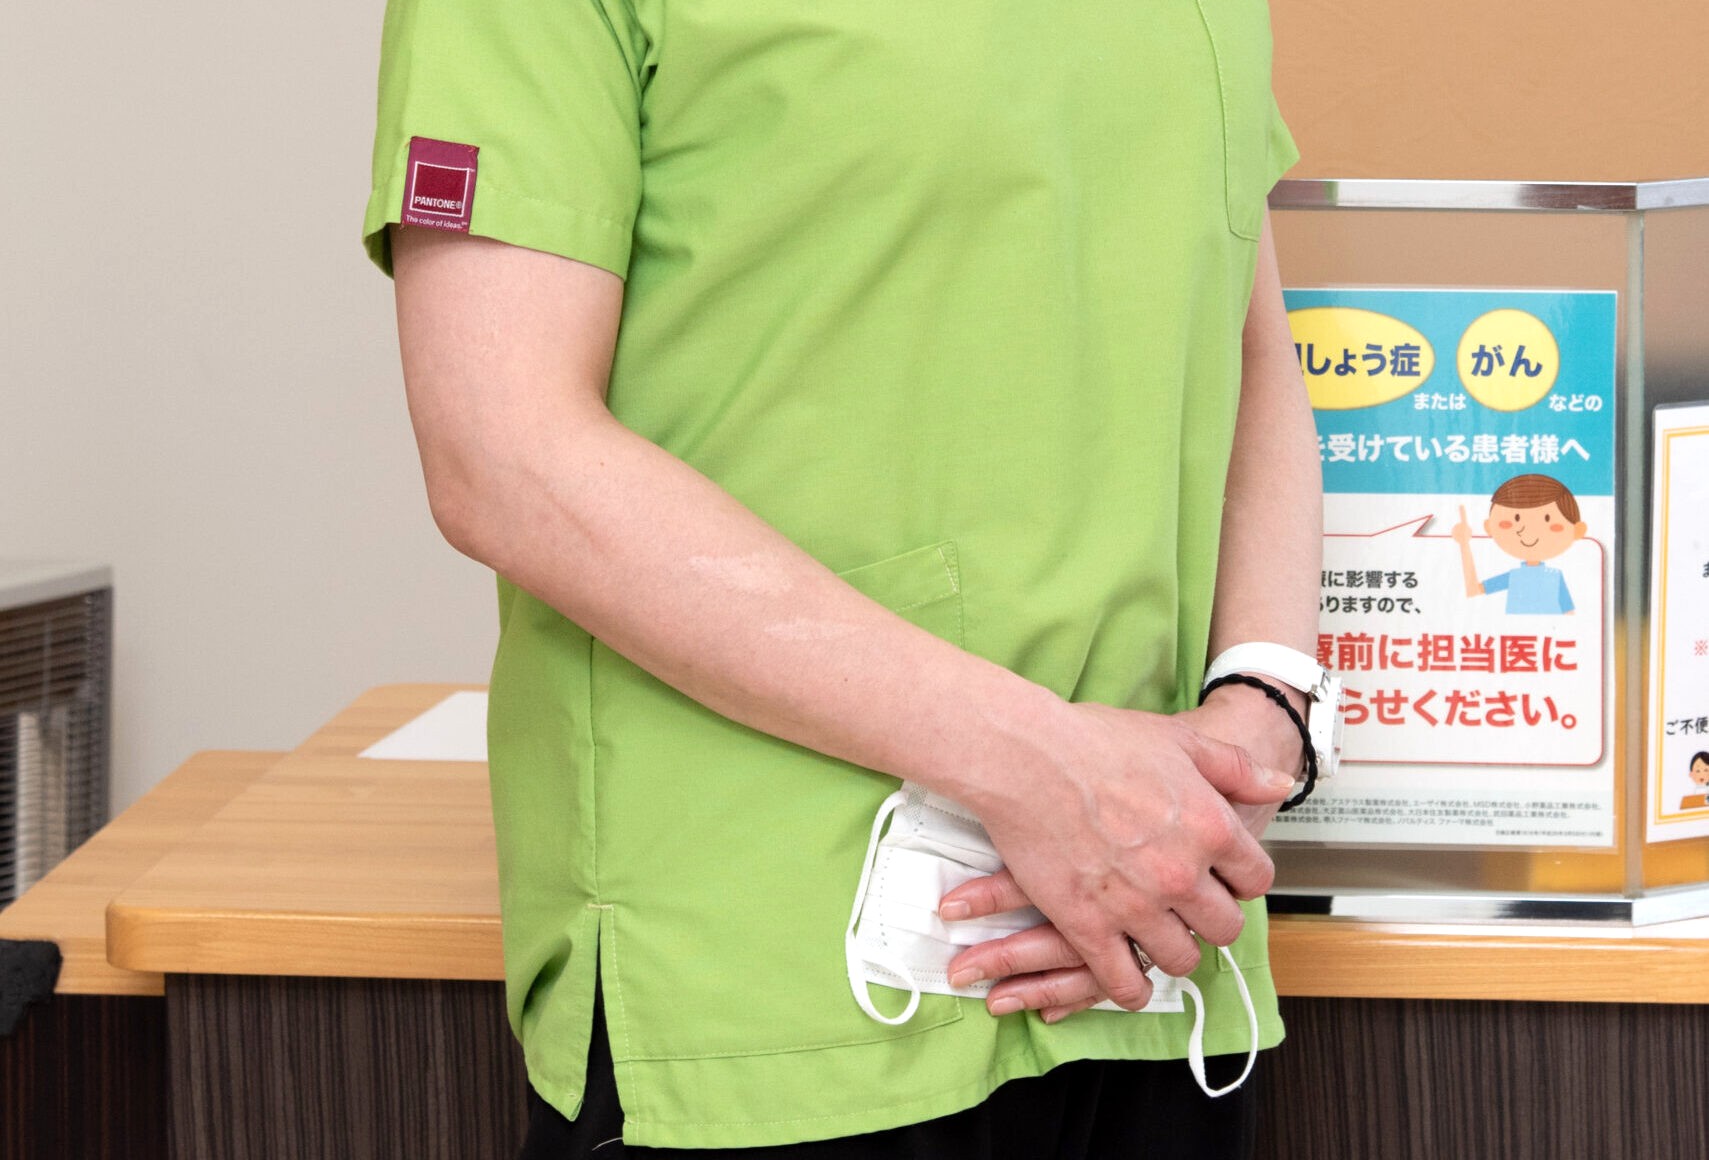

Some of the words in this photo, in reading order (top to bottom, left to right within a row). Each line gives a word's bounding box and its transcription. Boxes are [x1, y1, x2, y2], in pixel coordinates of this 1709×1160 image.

[406, 215, 419, 223] The
[419, 218, 436, 226] color
[1295, 343, 1422, 378] しょう症
[1413, 392, 1467, 411] または
[1471, 344, 1543, 378] がん
[1549, 393, 1603, 413] などの
